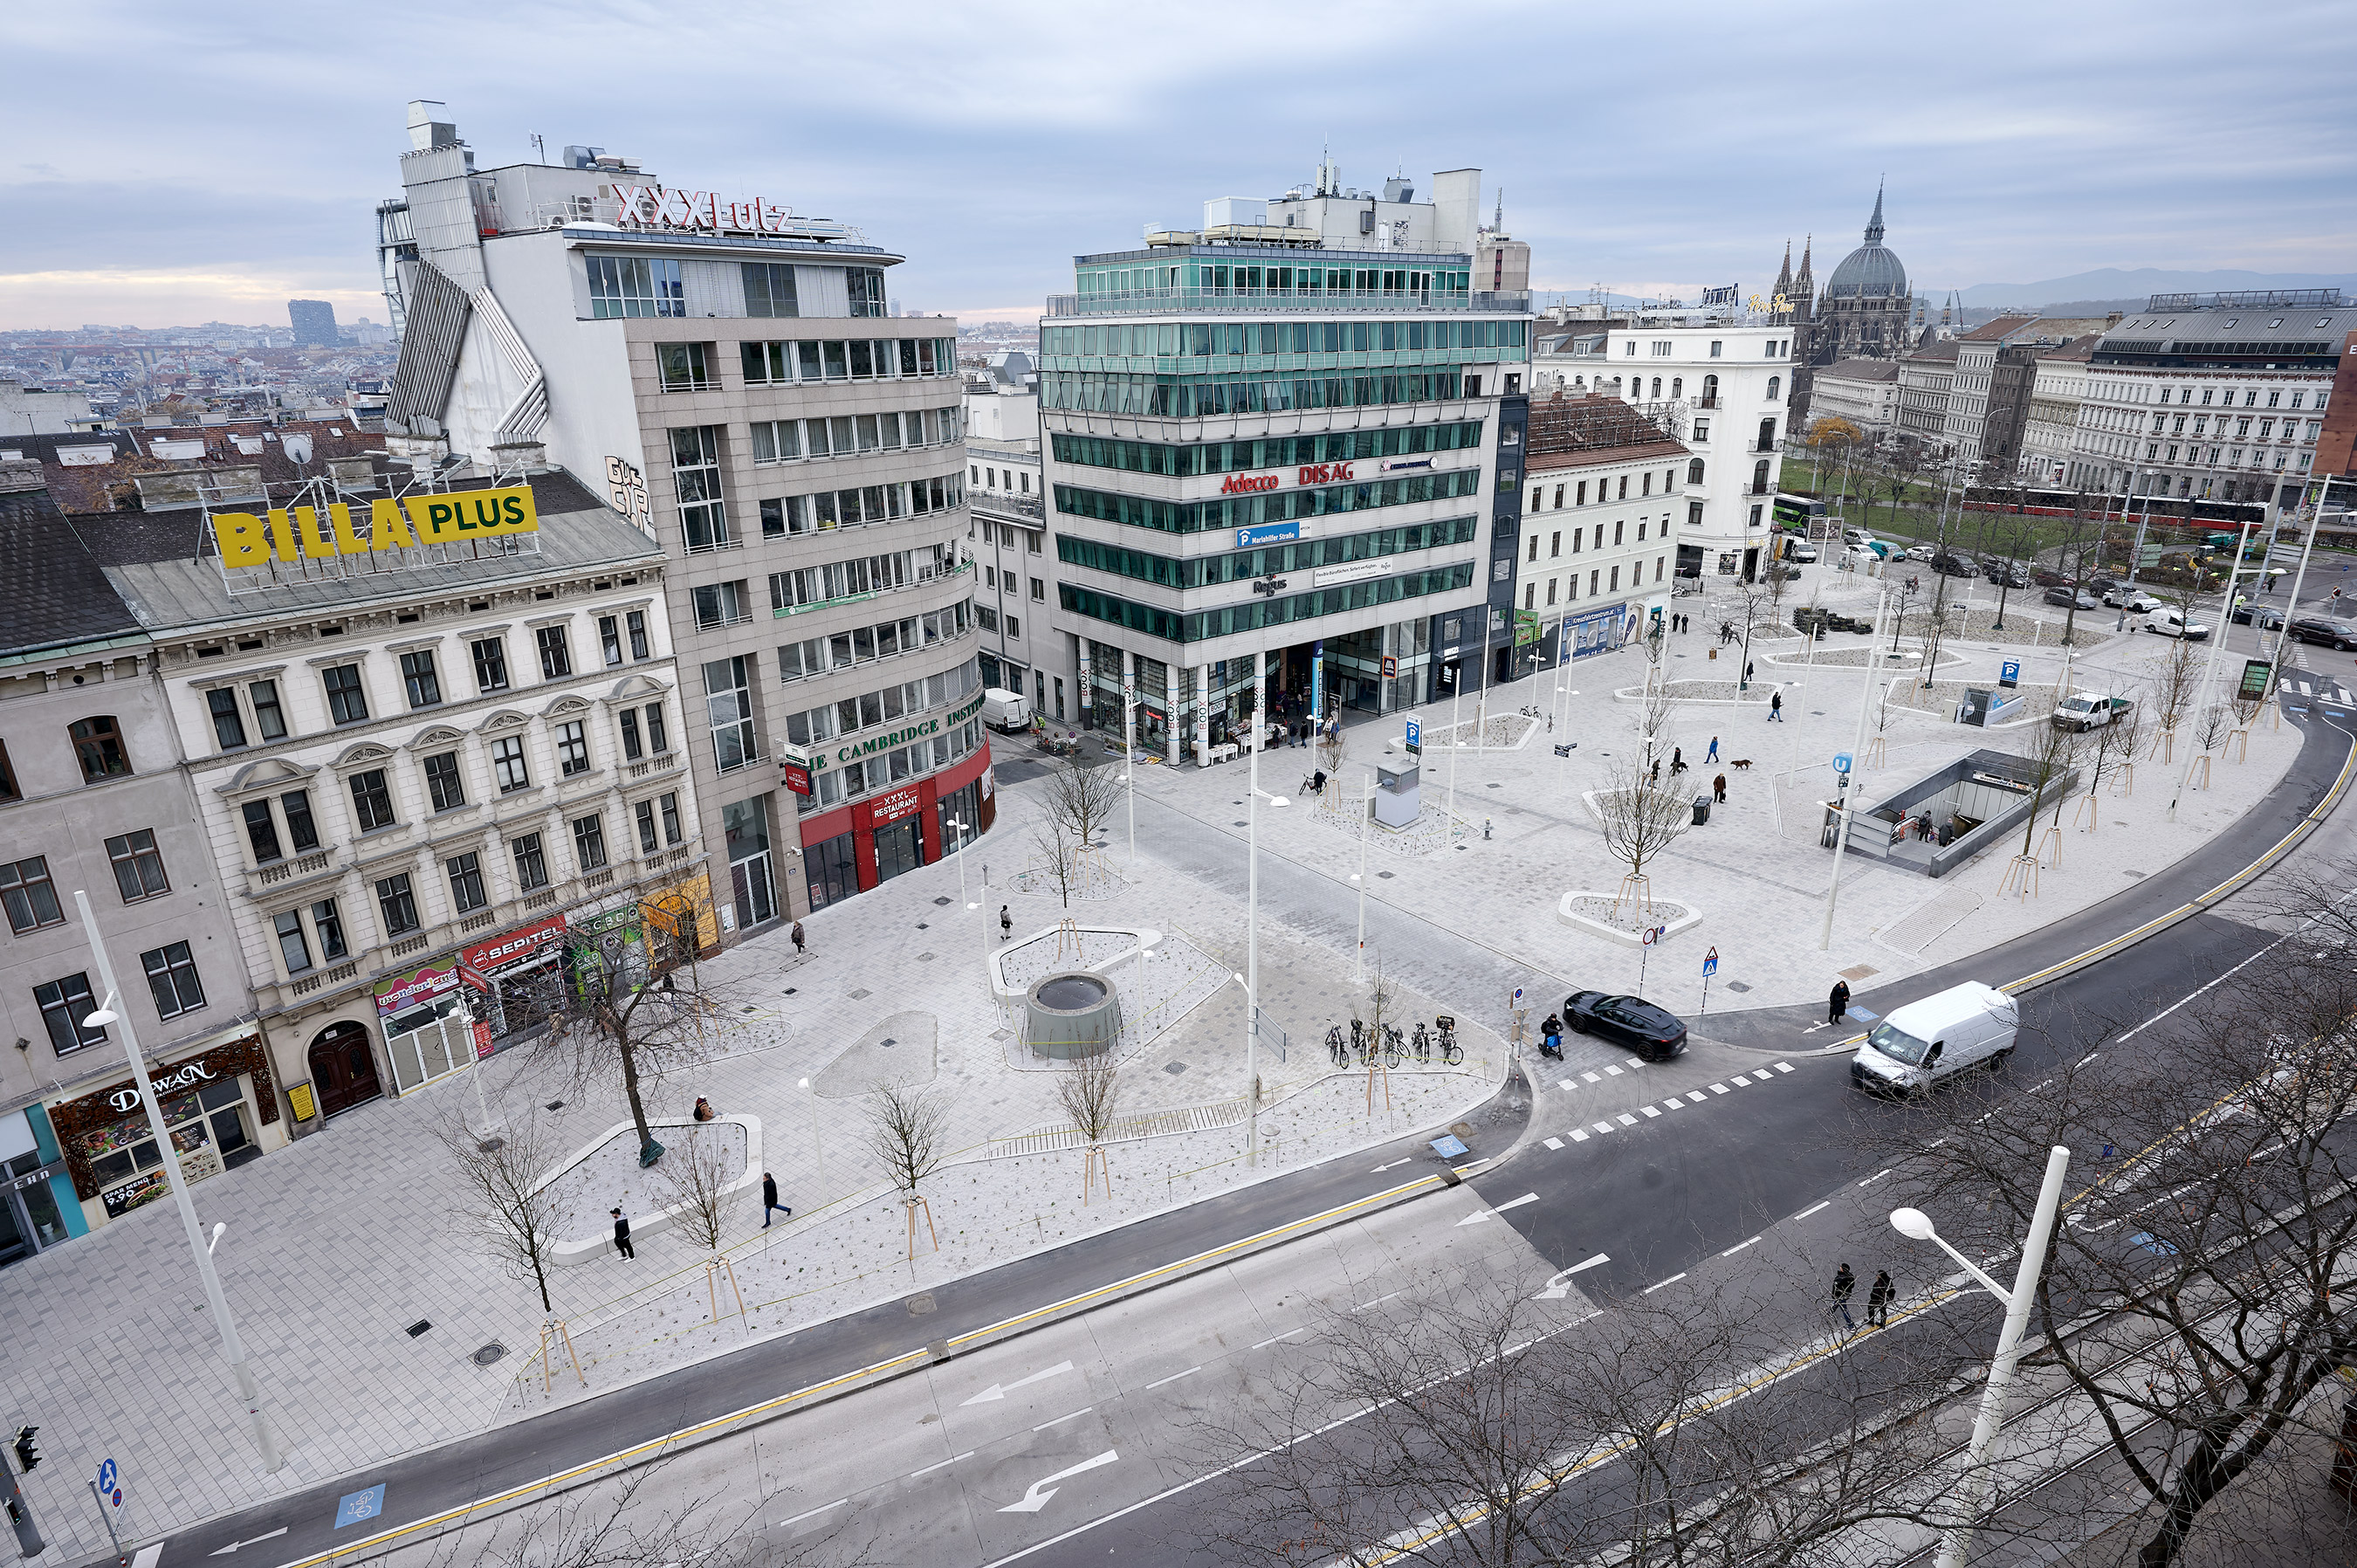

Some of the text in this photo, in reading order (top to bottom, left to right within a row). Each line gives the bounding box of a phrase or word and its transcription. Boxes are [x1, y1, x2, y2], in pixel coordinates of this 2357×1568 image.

[612, 184, 795, 233] XXXLutz
[1221, 473, 1280, 494] Adecco
[1299, 462, 1354, 485] DIS AG
[428, 496, 526, 534] PLUS
[212, 498, 415, 569] BILLA
[1252, 532, 1295, 544] Mariahilfer Straße
[1254, 577, 1287, 597] Regus
[1211, 701, 1225, 712] BOOX
[838, 719, 939, 762] CAMBRIDGE
[874, 795, 918, 818] RESTAURANT
[594, 912, 625, 930] CBD
[489, 926, 561, 959] SEPITEL
[378, 968, 457, 1006] wonderland
[109, 1060, 217, 1112] DWAN
[105, 1187, 126, 1200] SPAR
[107, 1189, 135, 1206] 9.90
